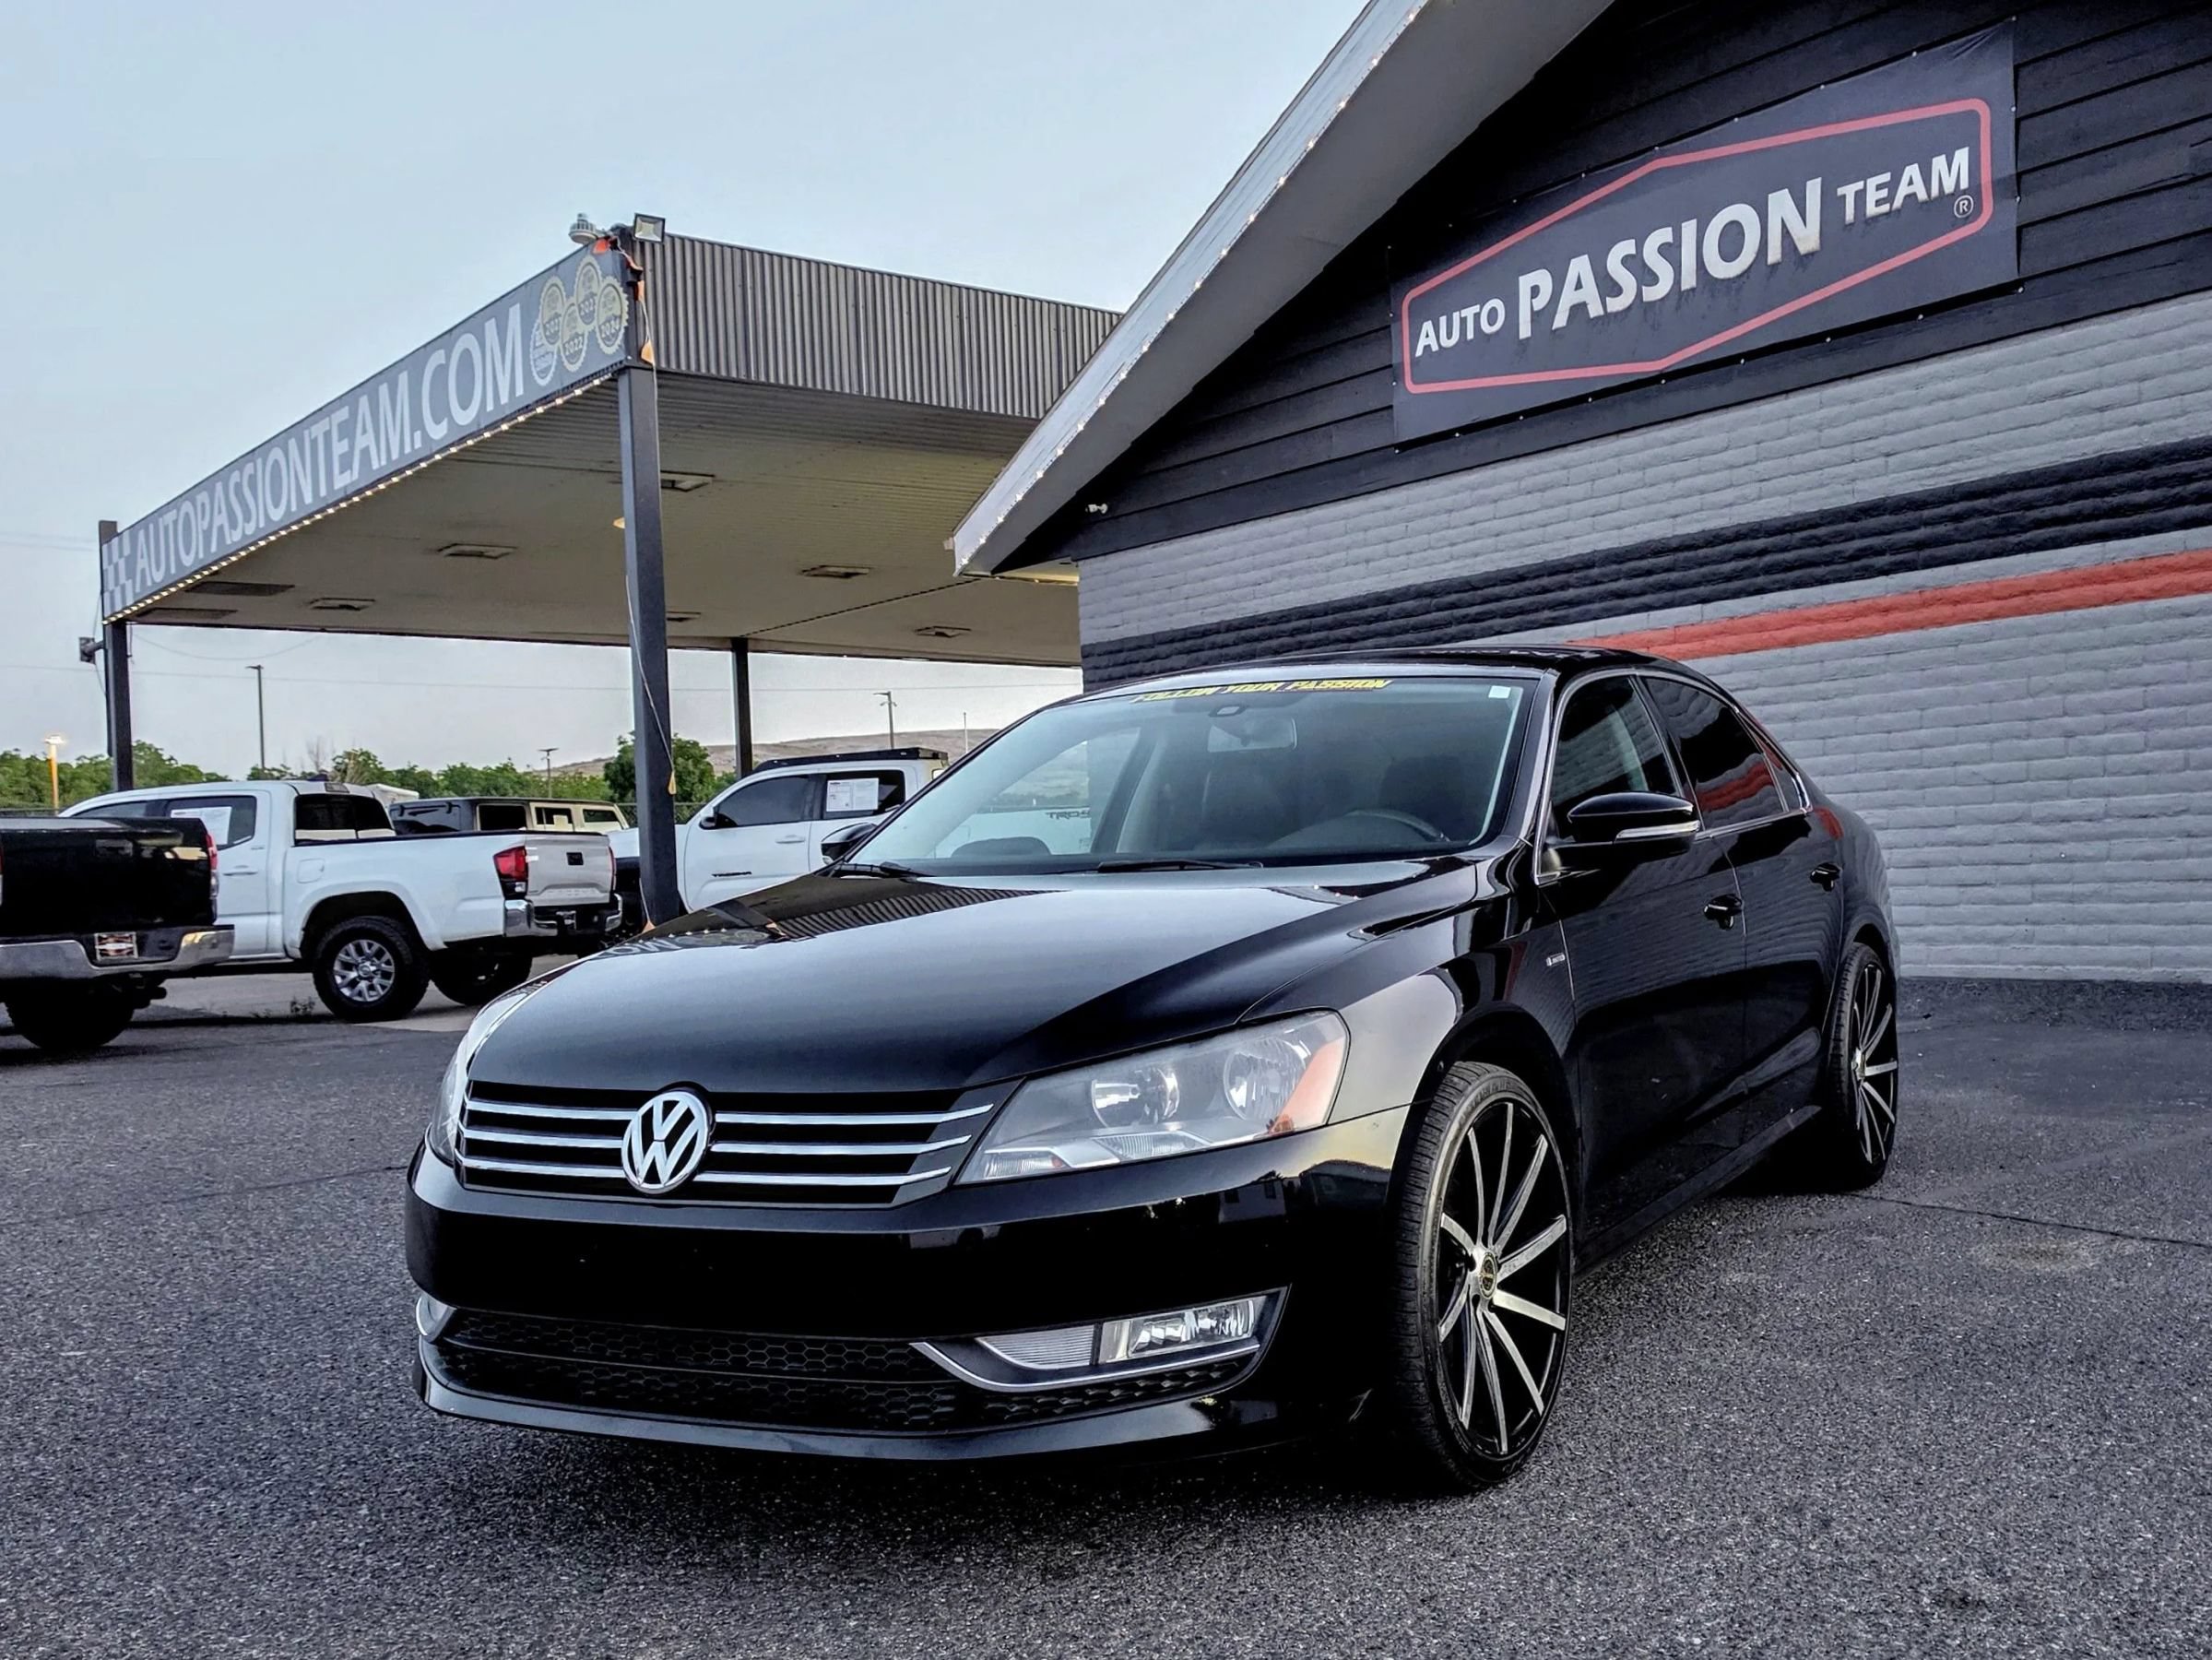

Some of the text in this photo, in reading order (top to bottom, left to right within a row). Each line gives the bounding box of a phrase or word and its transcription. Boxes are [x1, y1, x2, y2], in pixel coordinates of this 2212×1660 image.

[1414, 298, 1506, 358] AUTO
[1519, 177, 1823, 339] PASSION
[1837, 146, 1970, 225] TEAM
[135, 302, 525, 593] AUTOPASSIONTEAM.COM
[1283, 679, 1393, 691] PASSION
